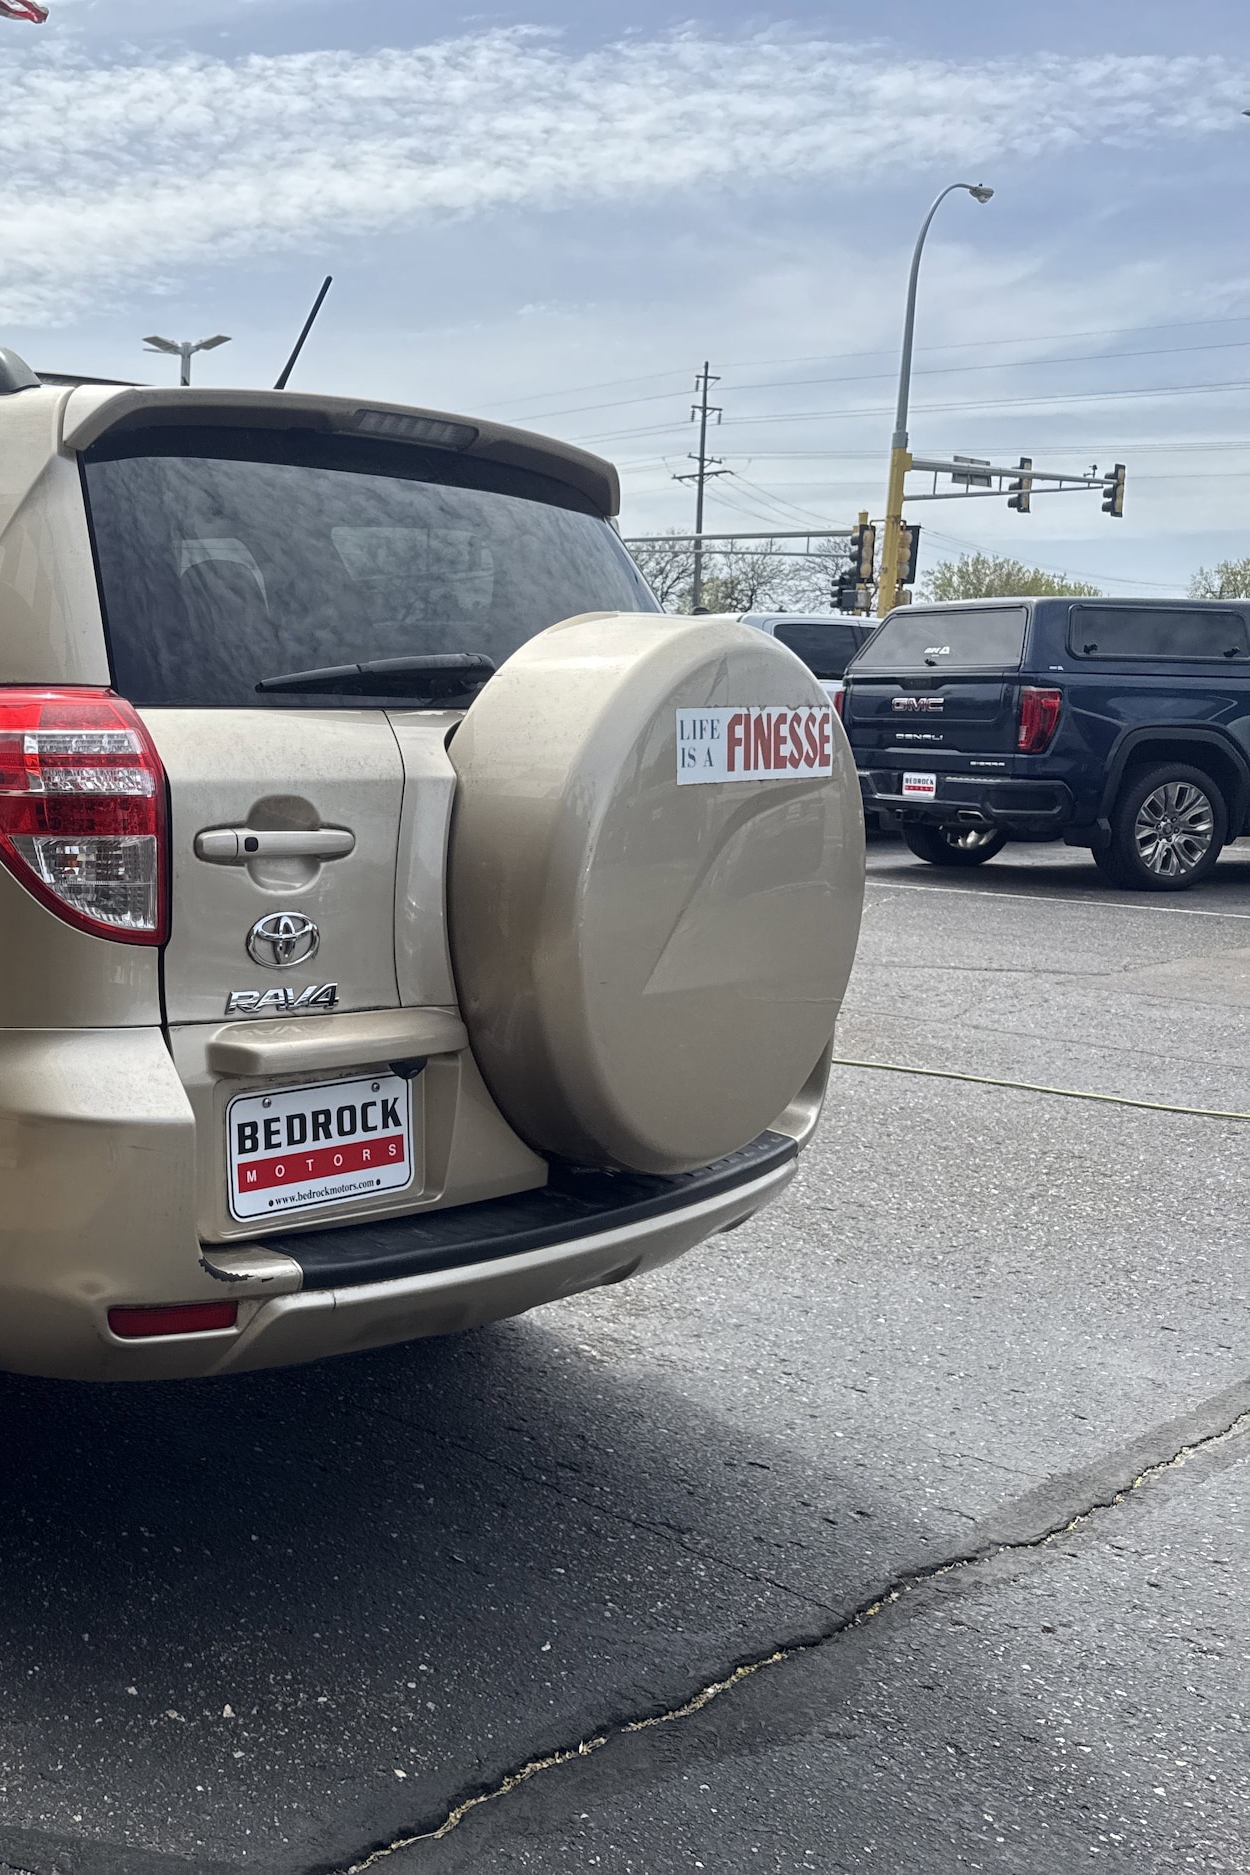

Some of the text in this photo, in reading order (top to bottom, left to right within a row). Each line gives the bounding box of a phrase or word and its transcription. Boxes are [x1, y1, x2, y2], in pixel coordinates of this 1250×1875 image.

[892, 697, 944, 712] GMC
[680, 718, 720, 741] LIFE
[727, 711, 831, 772] FINESSE
[681, 746, 714, 769] IS A
[224, 982, 340, 1015] RAV4
[237, 1097, 403, 1156] BEDROCK
[246, 1143, 398, 1183] MOTORS
[275, 1178, 375, 1206] www.bedrockmotors.com
